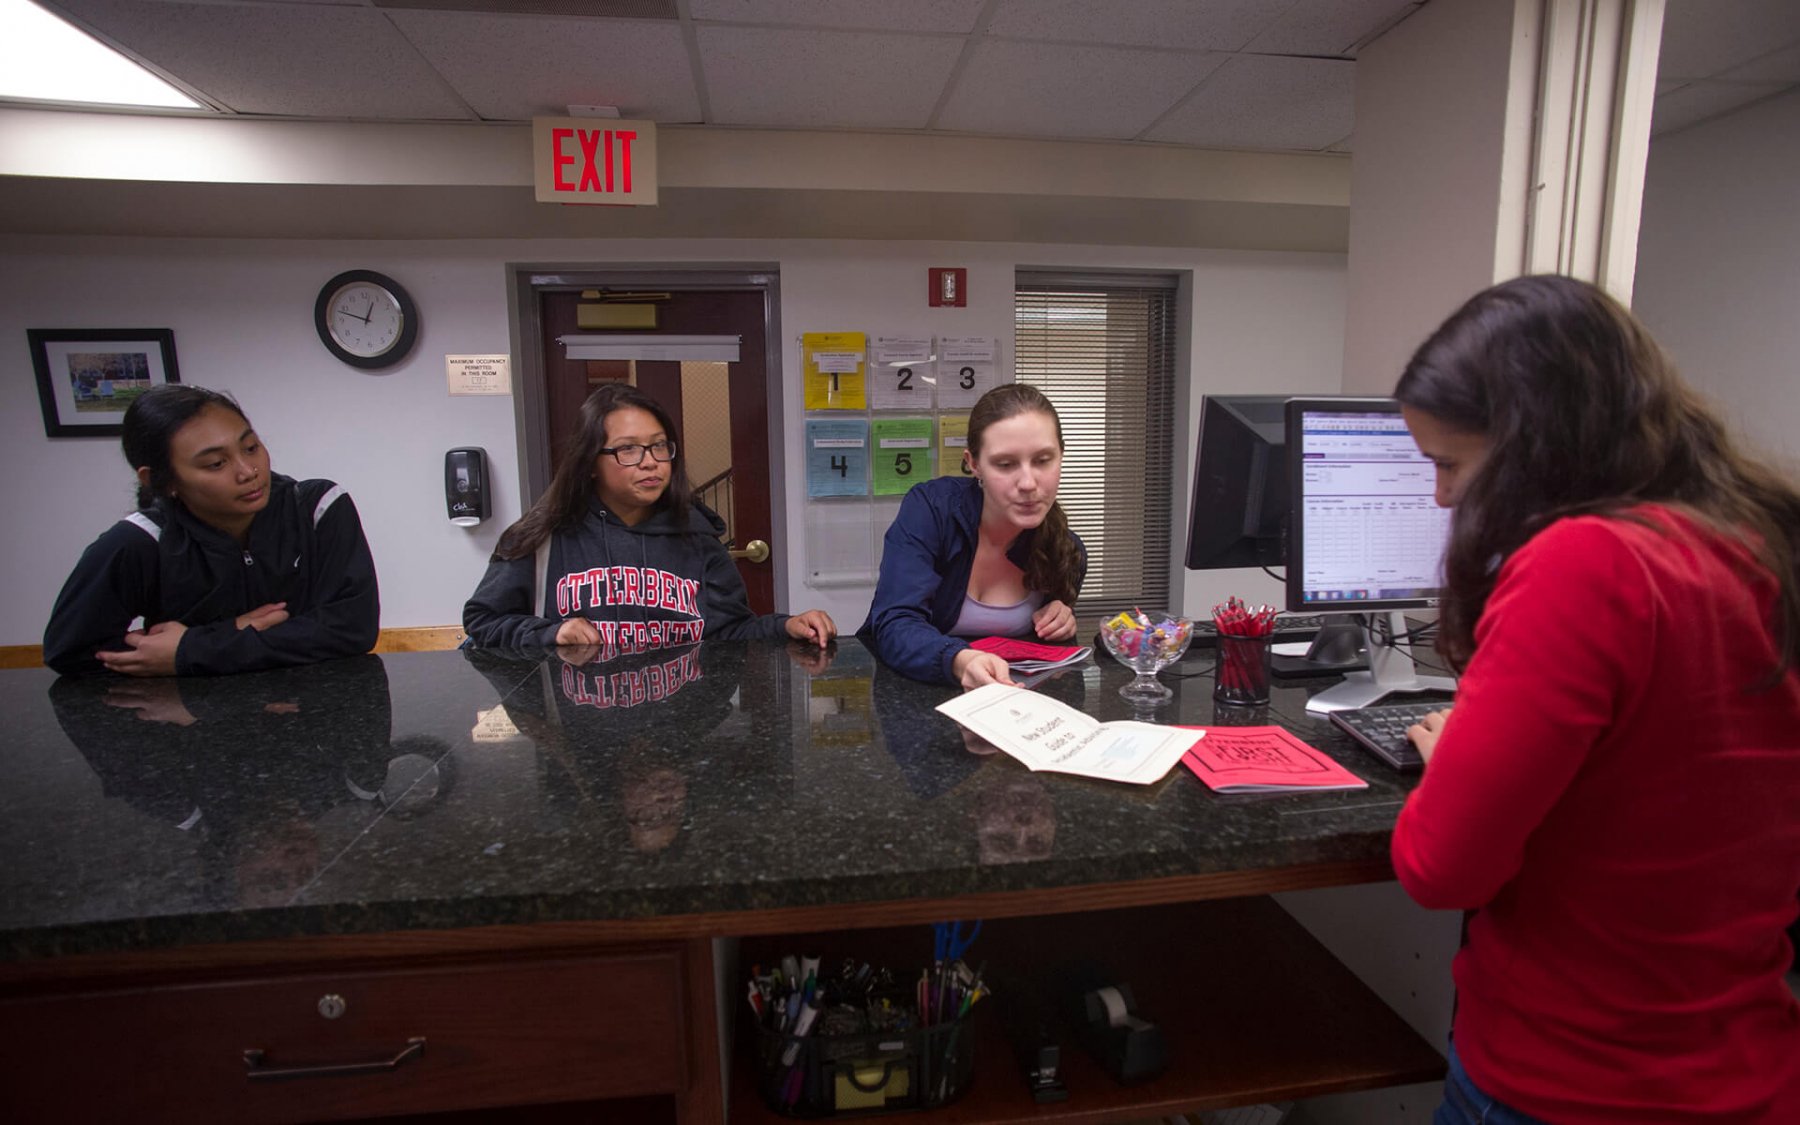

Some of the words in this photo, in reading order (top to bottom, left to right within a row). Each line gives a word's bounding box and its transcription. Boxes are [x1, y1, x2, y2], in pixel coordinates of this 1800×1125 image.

[552, 127, 637, 193] EXIT
[831, 372, 838, 390] 1
[897, 368, 913, 390] 2
[959, 367, 976, 390] 3
[831, 456, 848, 478] 4
[894, 453, 912, 476] 5
[556, 566, 701, 618] OTTERBEIN
[563, 618, 704, 645] VERSITY
[1035, 716, 1066, 735] Student
[1045, 737, 1068, 750] Guide
